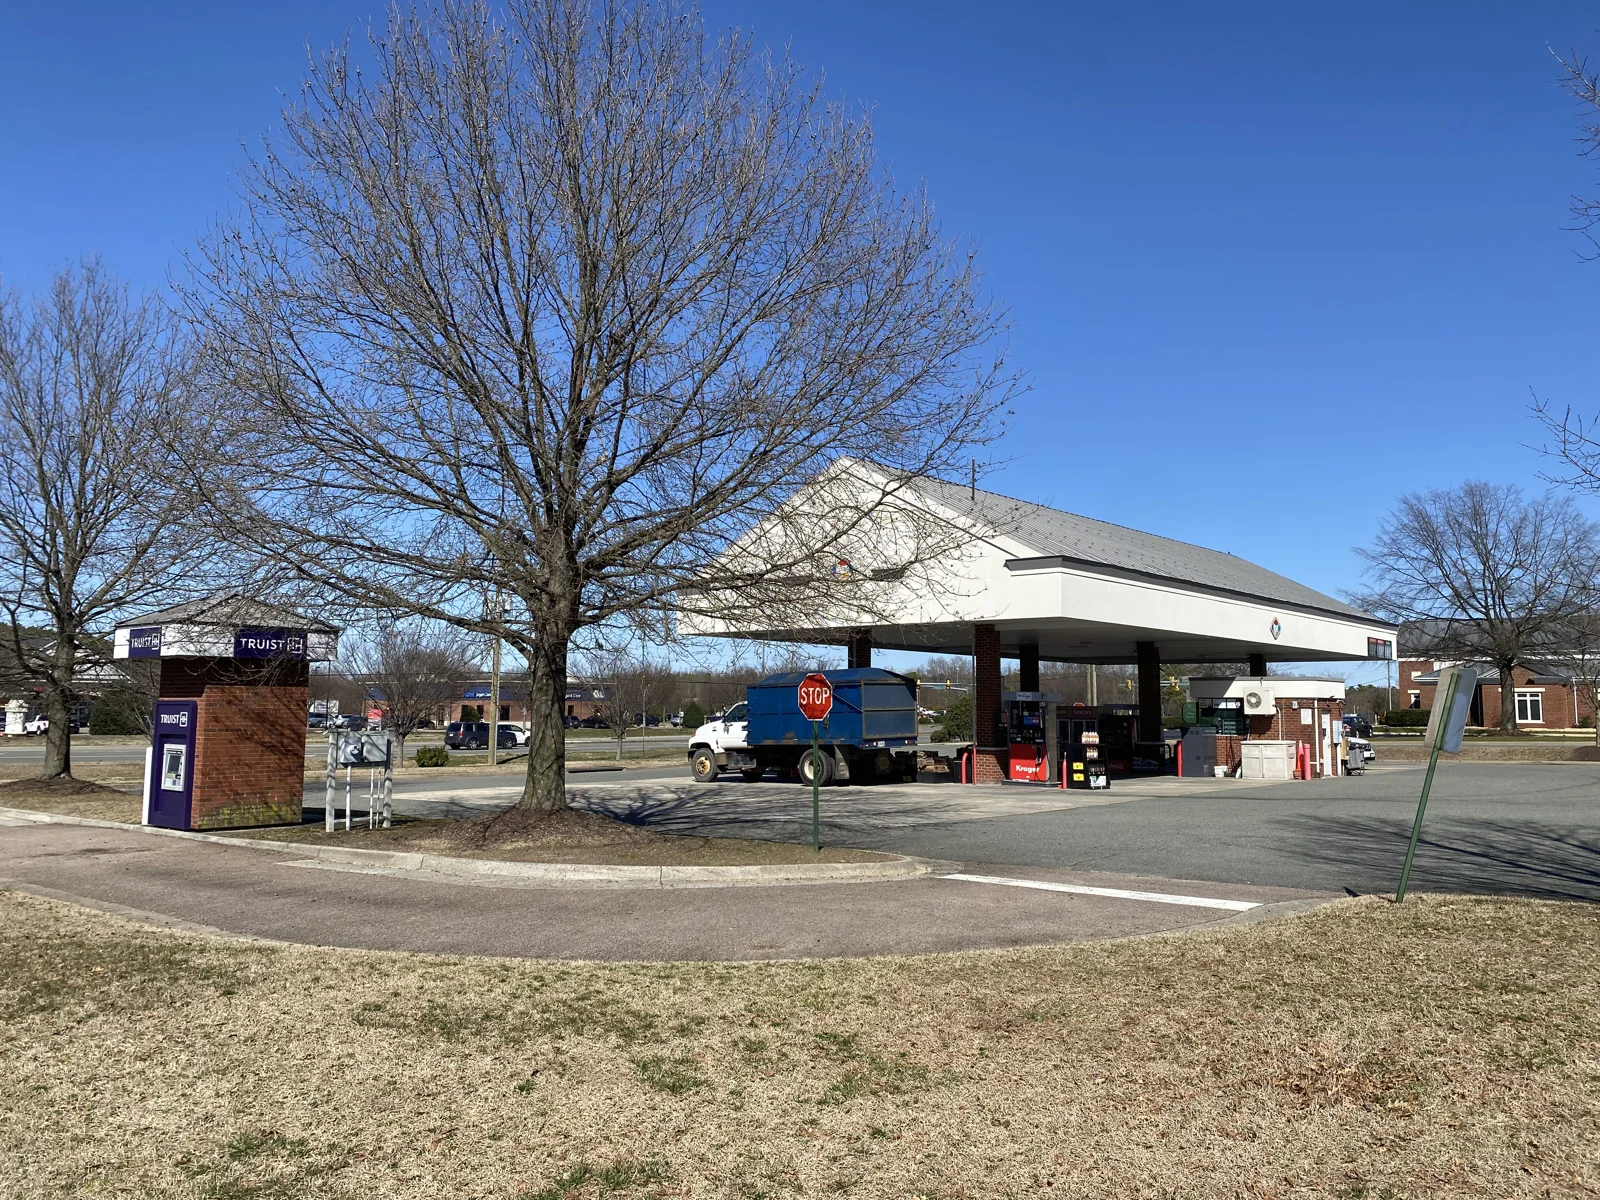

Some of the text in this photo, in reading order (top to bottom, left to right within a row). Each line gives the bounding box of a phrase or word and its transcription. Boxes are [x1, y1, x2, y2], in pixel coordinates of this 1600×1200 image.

[131, 637, 151, 649] TRUIST
[240, 638, 285, 650] TRUIST
[800, 687, 830, 705] STOP
[160, 714, 179, 723] TRUIST
[1015, 764, 1040, 774] Kroger
